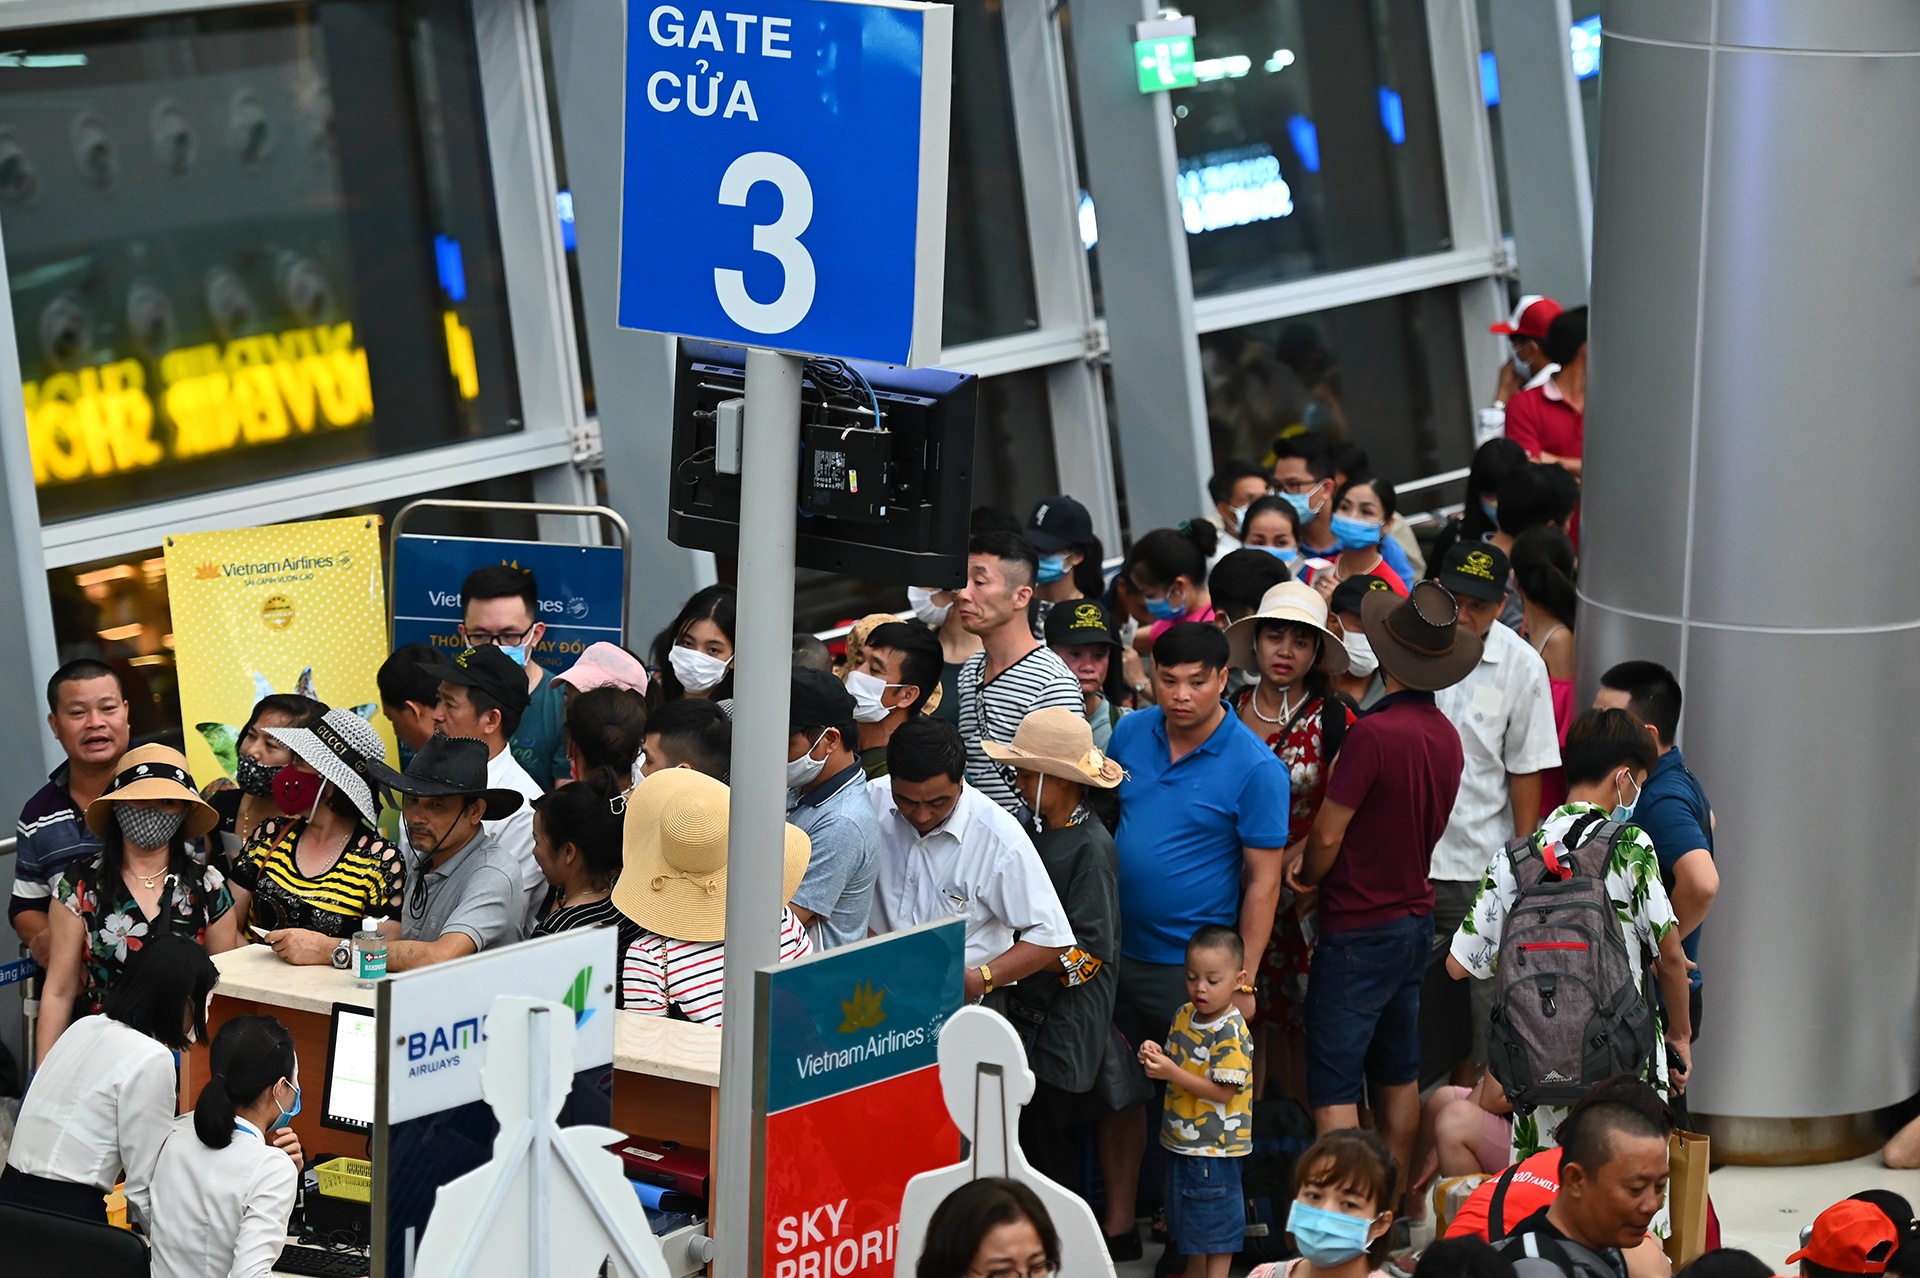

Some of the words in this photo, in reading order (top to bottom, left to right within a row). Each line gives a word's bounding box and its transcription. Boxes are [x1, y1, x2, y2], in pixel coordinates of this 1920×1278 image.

[649, 5, 792, 59] GATE
[646, 59, 759, 122] CỬA
[714, 151, 816, 335] 3
[222, 560, 281, 577] Vietnam
[282, 555, 334, 572] Airlines
[428, 591, 462, 607] Viet
[533, 640, 556, 653] AY
[316, 725, 348, 755] GUCCI
[408, 1055, 461, 1078] AIRWAYS
[796, 1045, 864, 1080] Vietnam
[864, 1026, 925, 1060] Airlines
[1527, 1175, 1560, 1193] FAMILY
[776, 1198, 849, 1255] SKY
